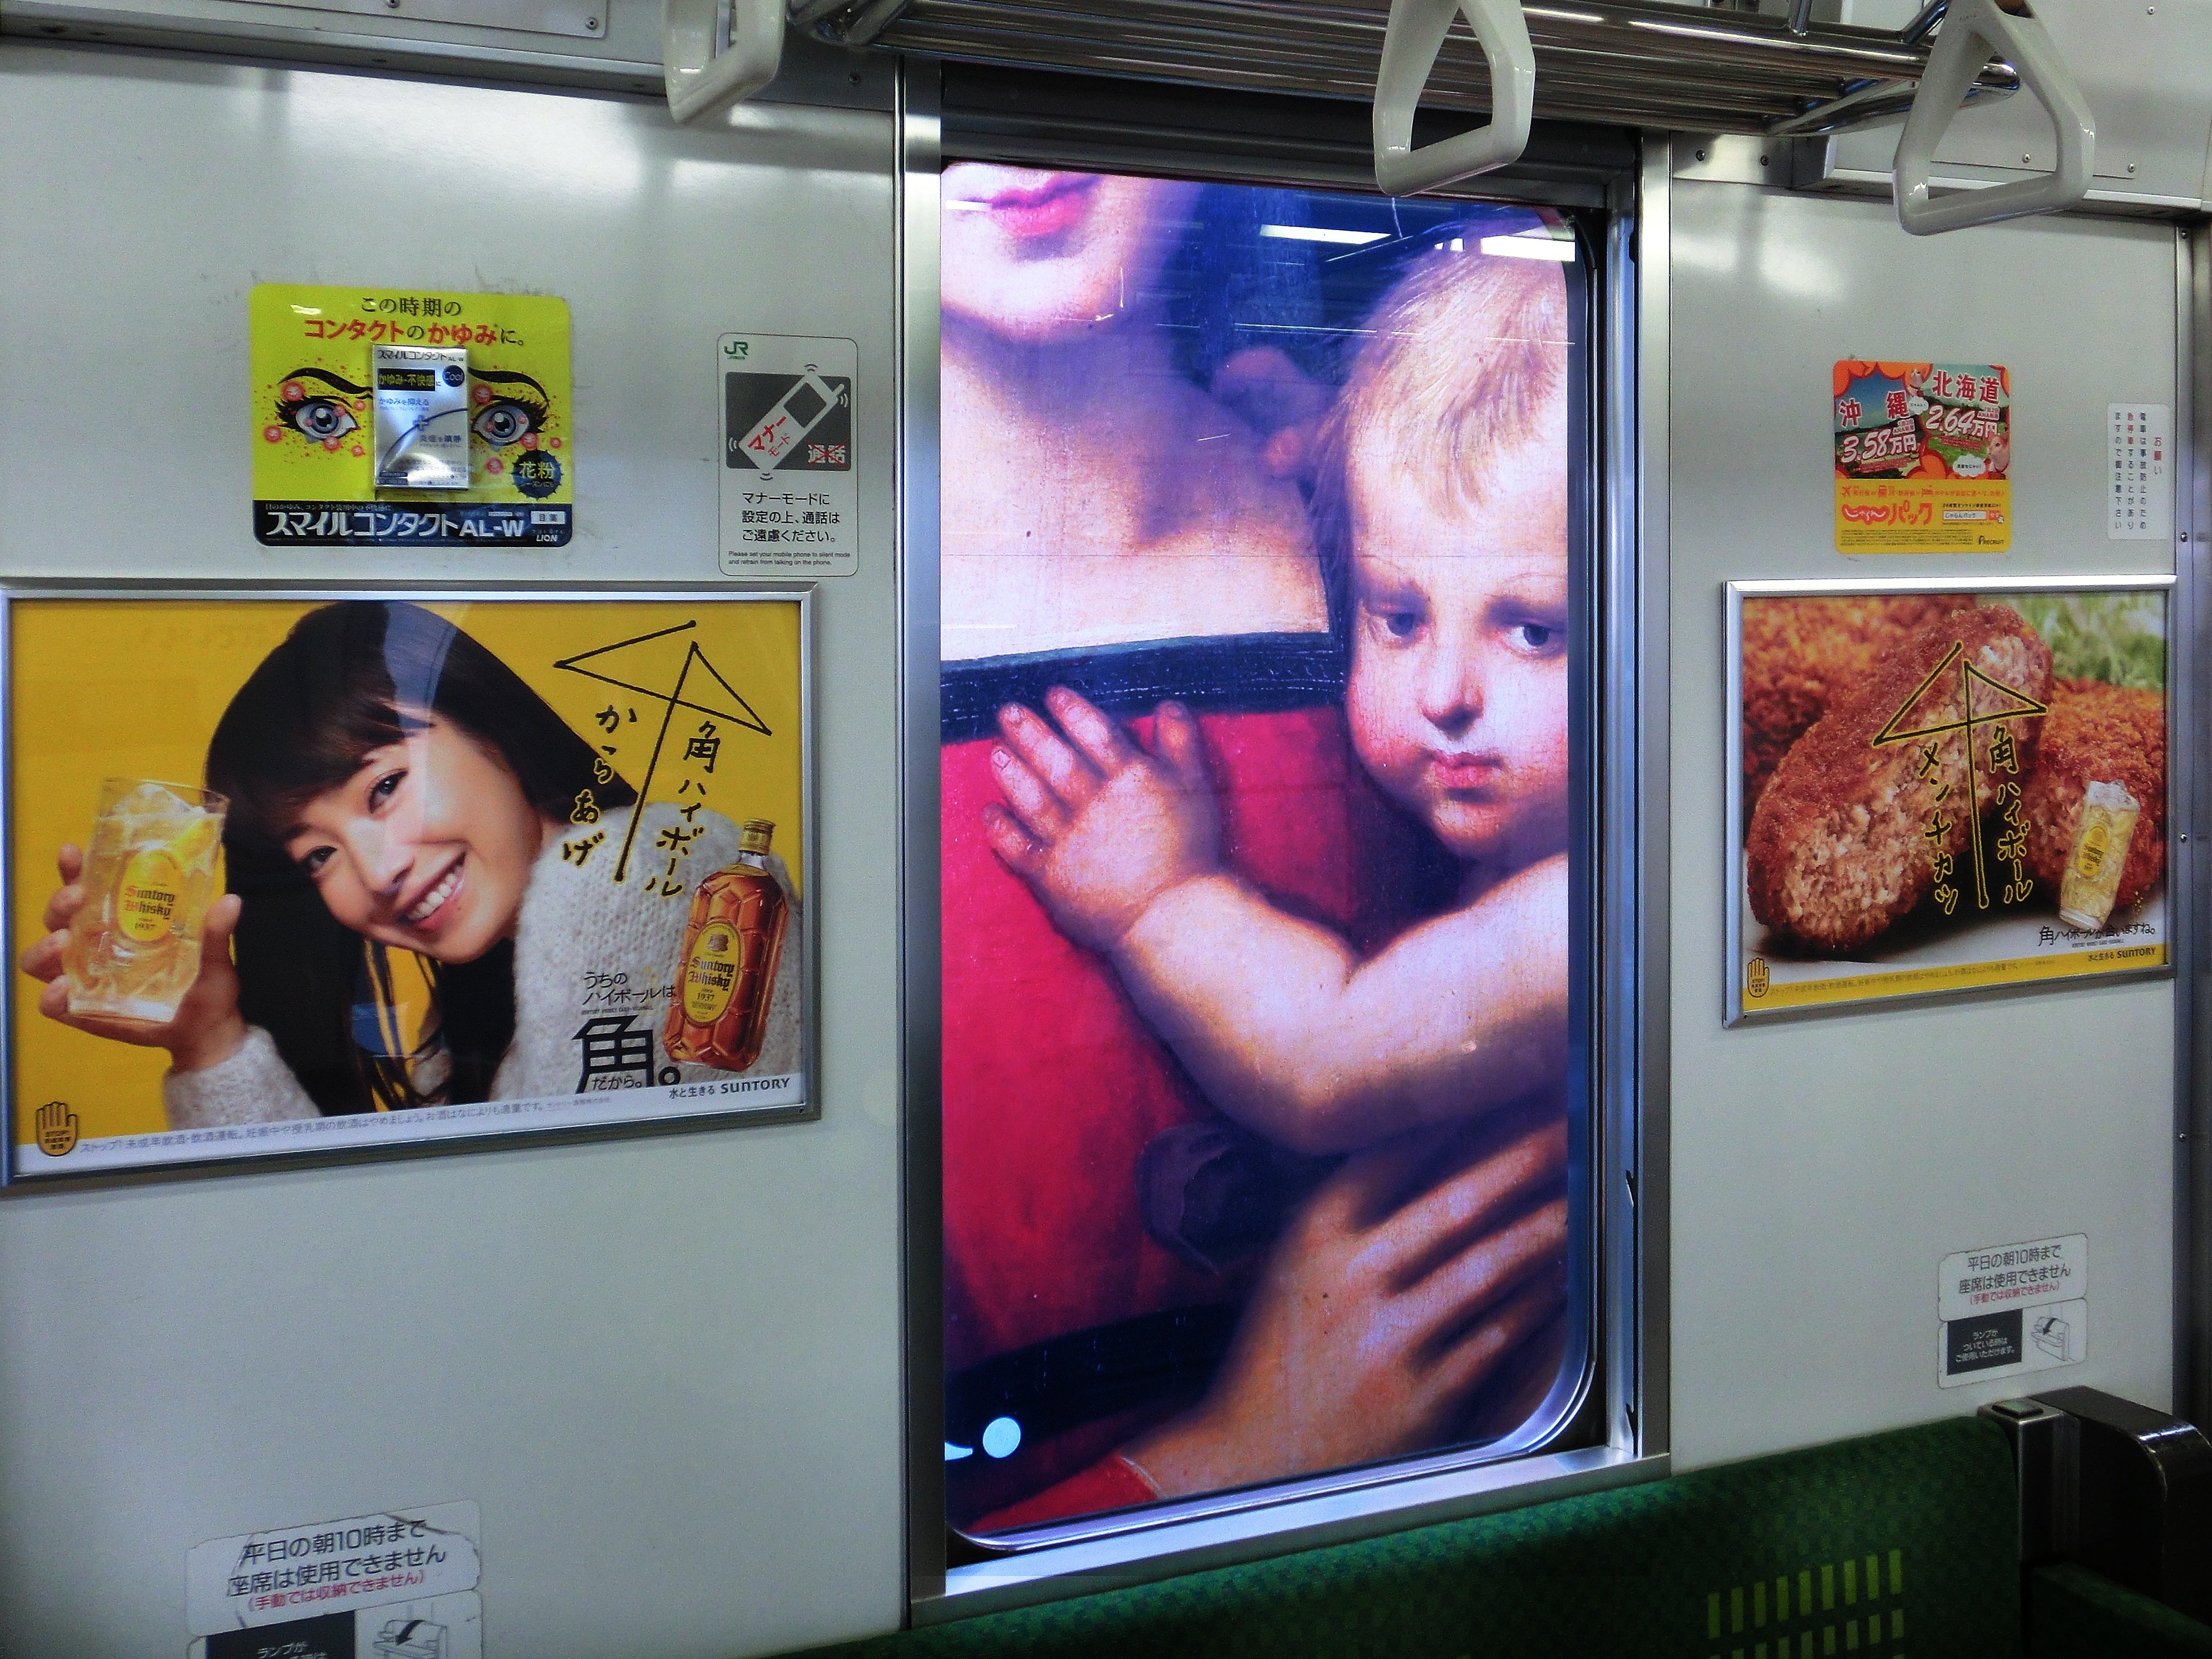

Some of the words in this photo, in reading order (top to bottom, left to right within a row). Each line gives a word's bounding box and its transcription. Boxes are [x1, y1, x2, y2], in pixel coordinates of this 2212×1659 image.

[361, 297, 462, 317] この時期の
[304, 319, 525, 347] コンタクトのかゆみに。
[724, 341, 748, 356] JR
[444, 371, 463, 381] Cool
[1932, 370, 2001, 405] 北海道
[1839, 390, 1910, 427] 沖縄
[1926, 405, 1998, 437] 2.64万円
[747, 416, 786, 451] マナー
[768, 432, 790, 457] モード
[1841, 429, 1917, 463] 3.58万円
[2153, 436, 2162, 475] お願い
[519, 461, 555, 479] 花粉
[742, 492, 830, 505] マナーモードに
[742, 510, 840, 525] 設定の上、通話は
[742, 529, 836, 542] ご遠慮ください。
[561, 704, 638, 867] からあげ
[645, 720, 721, 897] 角ハイボール
[1990, 725, 2033, 904] 角ハイボール
[1919, 741, 1958, 915] メンチカツ
[2088, 953, 2114, 962] 水と生きる
[2117, 946, 2157, 959] SUNTORY
[690, 956, 735, 978] Suntory
[584, 972, 628, 989] うちの
[582, 984, 676, 1005] ハイボールは
[697, 992, 715, 1002] 1937
[591, 1074, 642, 1091] だから。
[669, 1085, 716, 1099] 水と生きる
[721, 1077, 791, 1094] SUNTORY
[1968, 1245, 2062, 1271] 平日の朝10時まで
[1959, 1263, 2071, 1294] 座席は使用できません
[1970, 1280, 2060, 1305] (手動では収納できません)
[1973, 1329, 1999, 1340] ランプが
[242, 1519, 427, 1567] 平日の朝10時まで
[227, 1545, 446, 1597] 座席は使用できません
[248, 1569, 425, 1611] (手動では収納できません)
